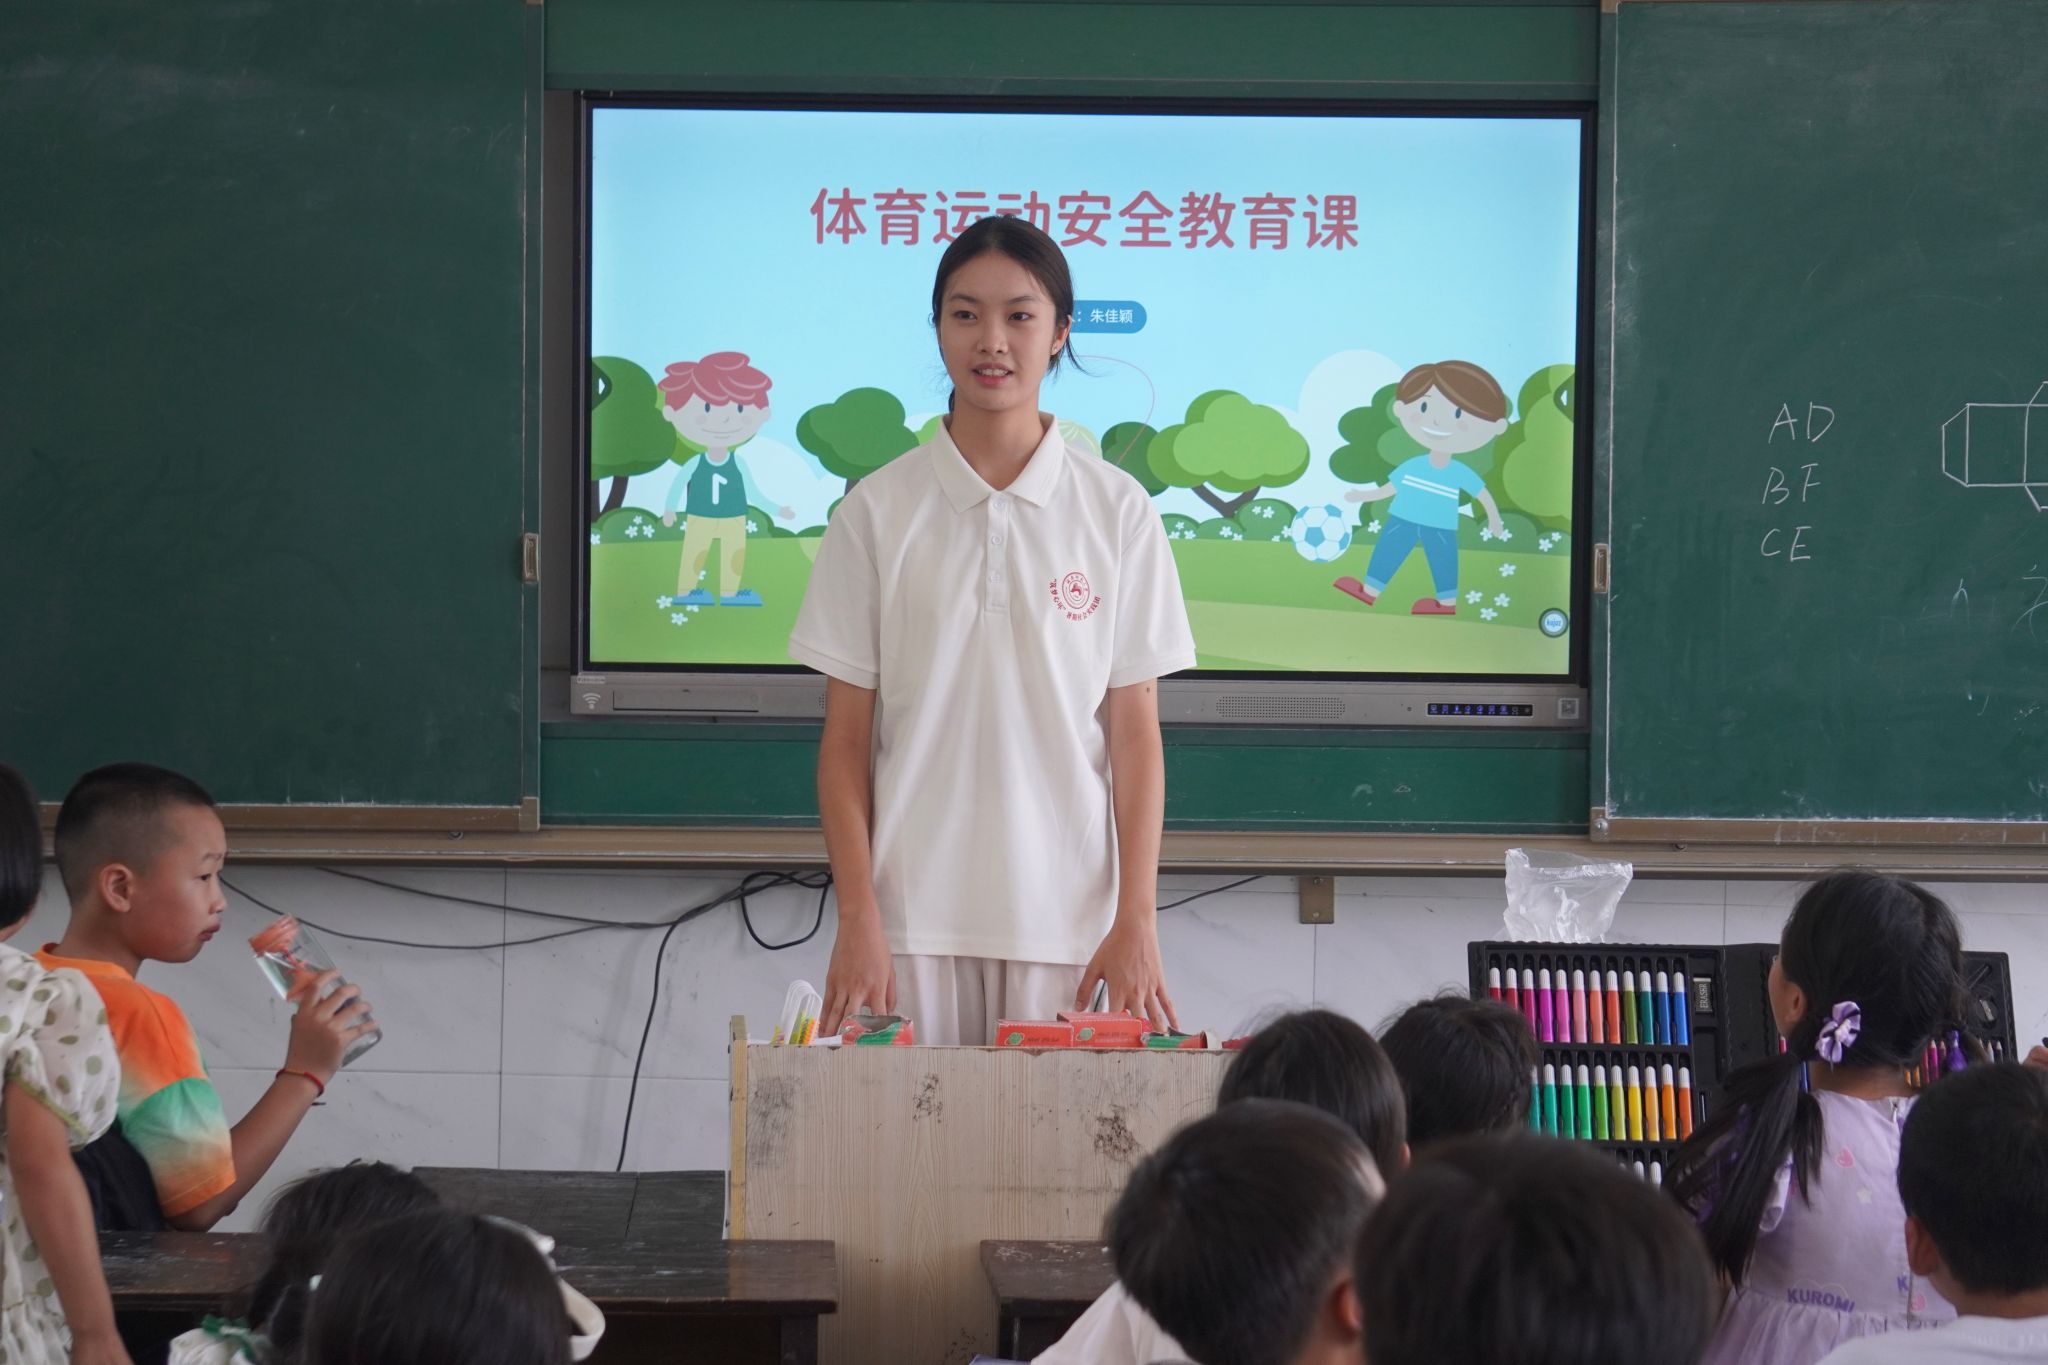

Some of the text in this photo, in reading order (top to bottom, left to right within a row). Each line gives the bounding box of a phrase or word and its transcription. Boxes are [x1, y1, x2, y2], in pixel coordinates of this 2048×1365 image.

[810, 187, 1359, 251] 体育运动安全教育课
[1787, 1288, 1855, 1313] KUROMI
